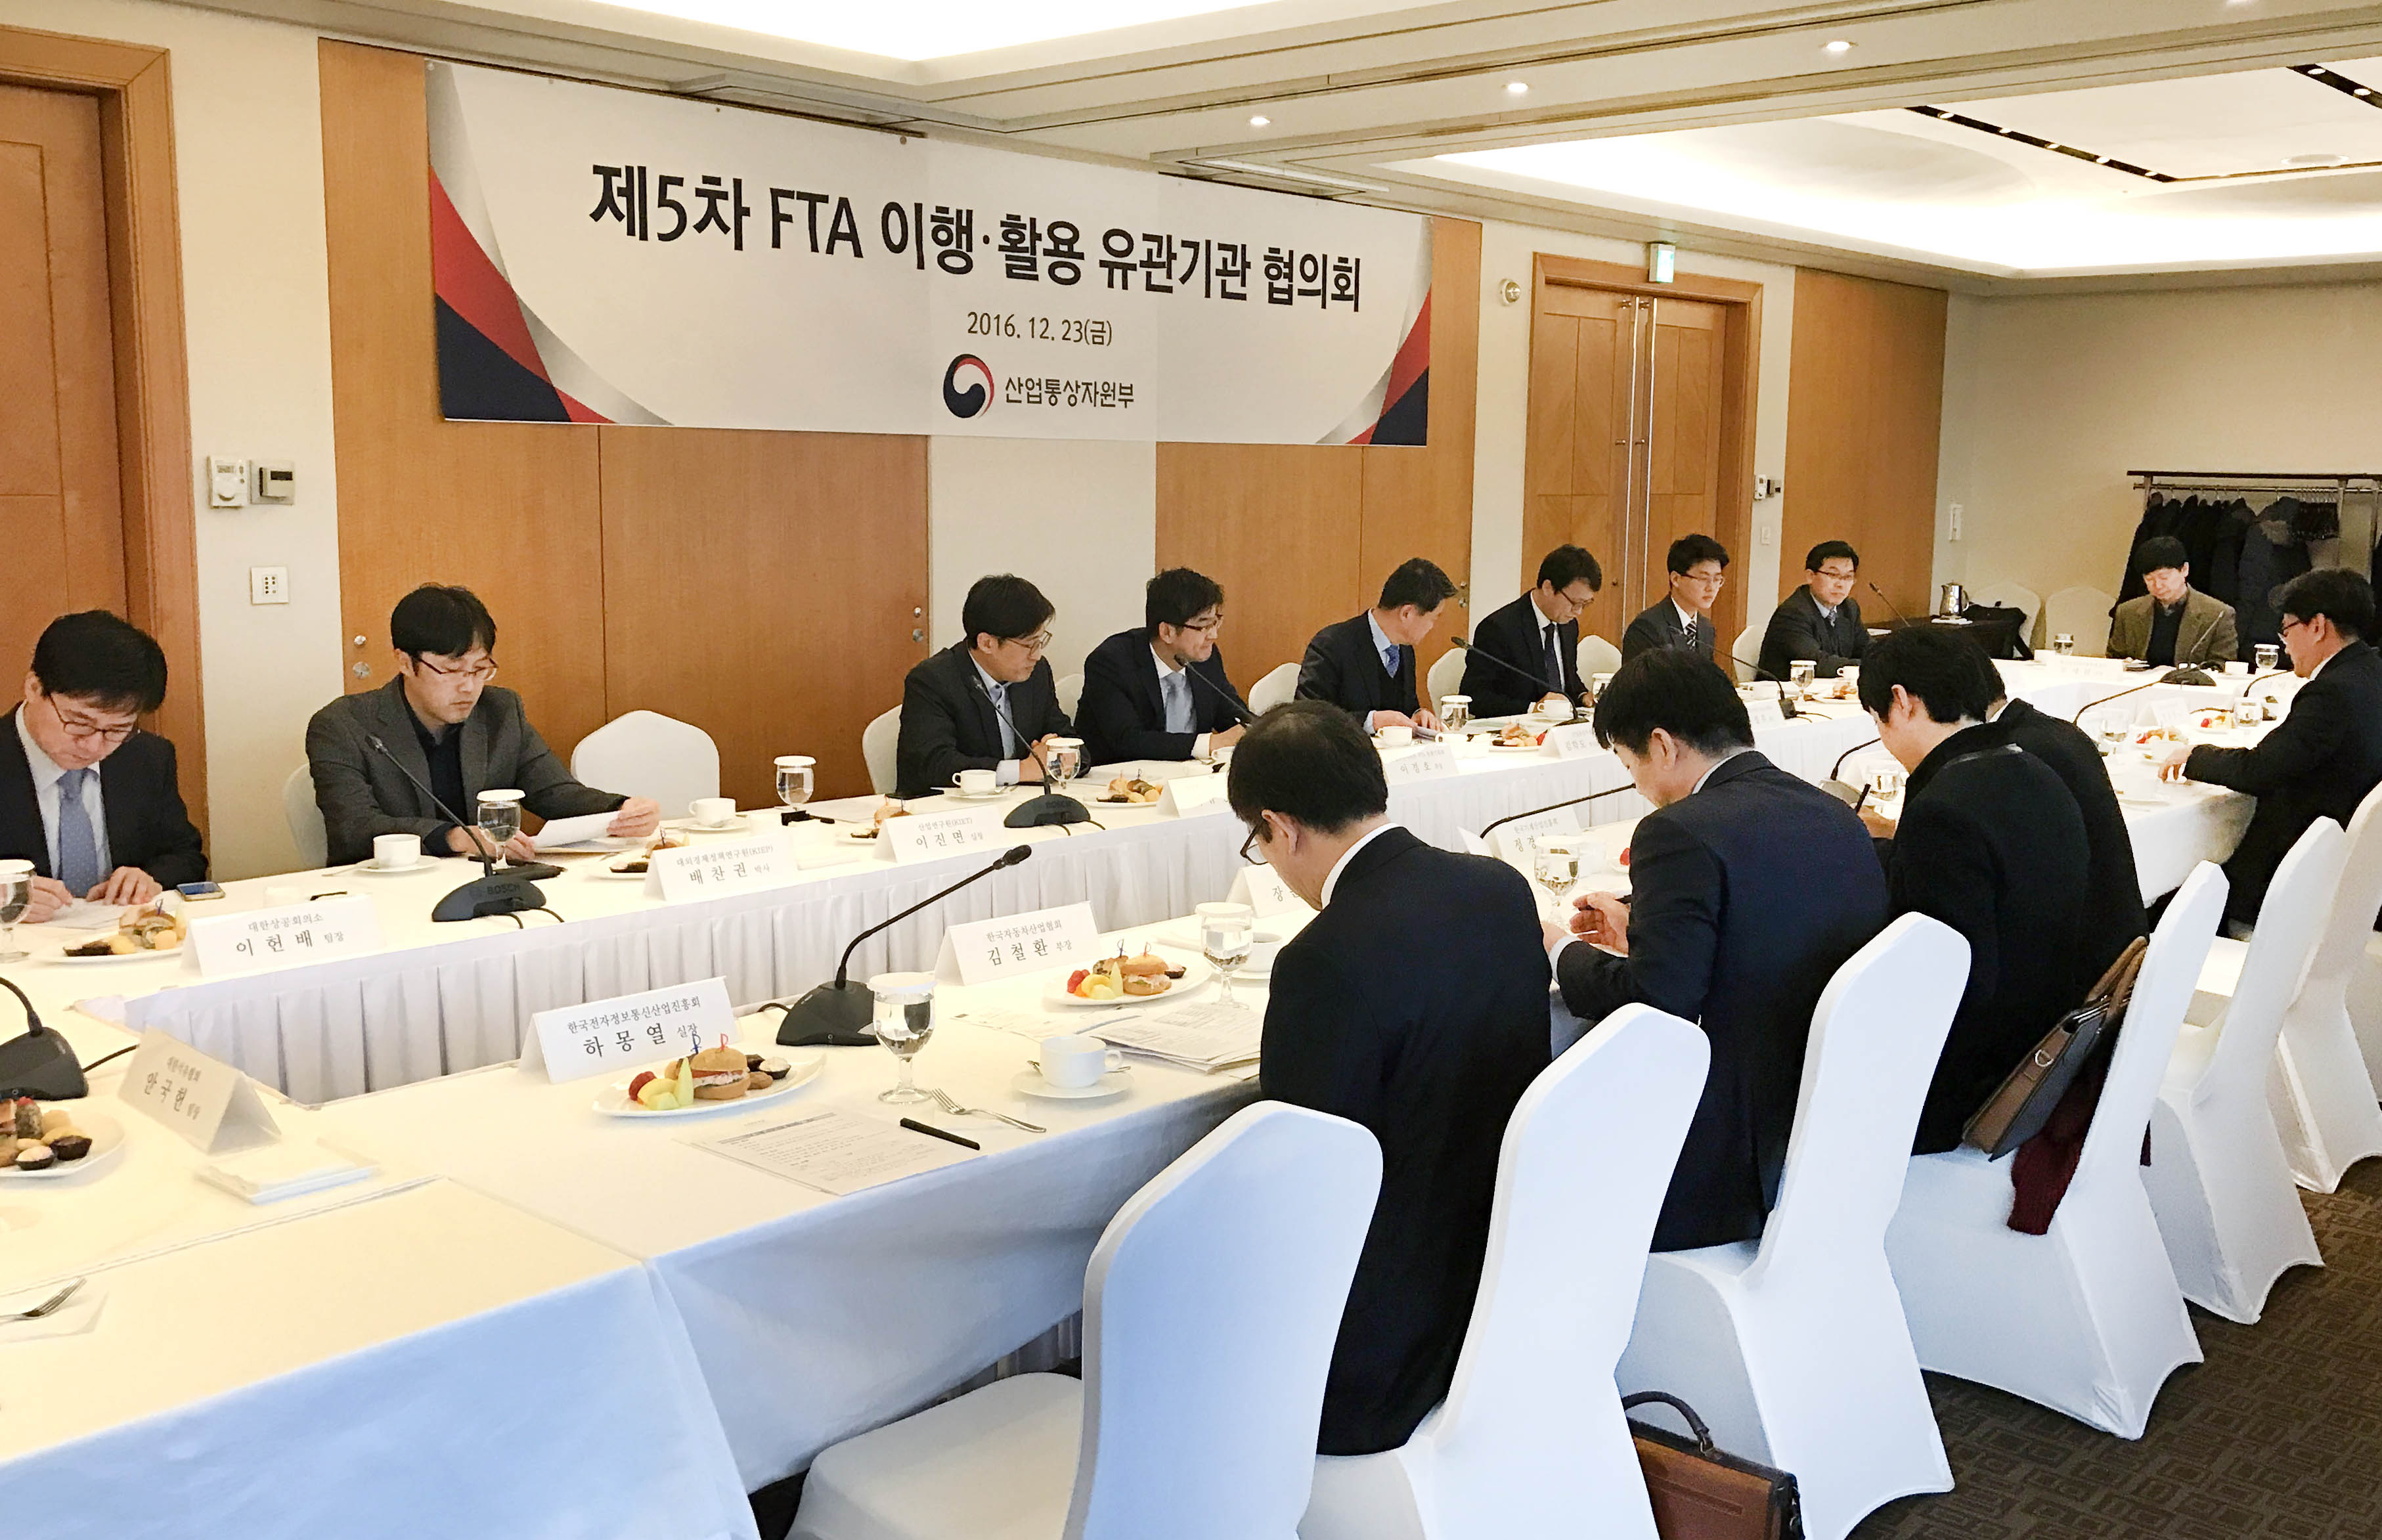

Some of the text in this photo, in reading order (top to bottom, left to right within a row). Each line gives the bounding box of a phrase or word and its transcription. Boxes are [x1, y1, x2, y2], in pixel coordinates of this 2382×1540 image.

[589, 164, 1361, 312] 제5차 FTA 이행·활용 유관기관 협의회
[967, 312, 1113, 347] 2016. 12. 23(금)
[1005, 376, 1134, 409] 산업통상자원부
[487, 883, 521, 895] BOSCH
[248, 913, 324, 933] 대한상공회의소
[986, 919, 1063, 942] 한국자동차산업협회
[568, 996, 701, 1034] 한국전자정보통신산업진흥회
